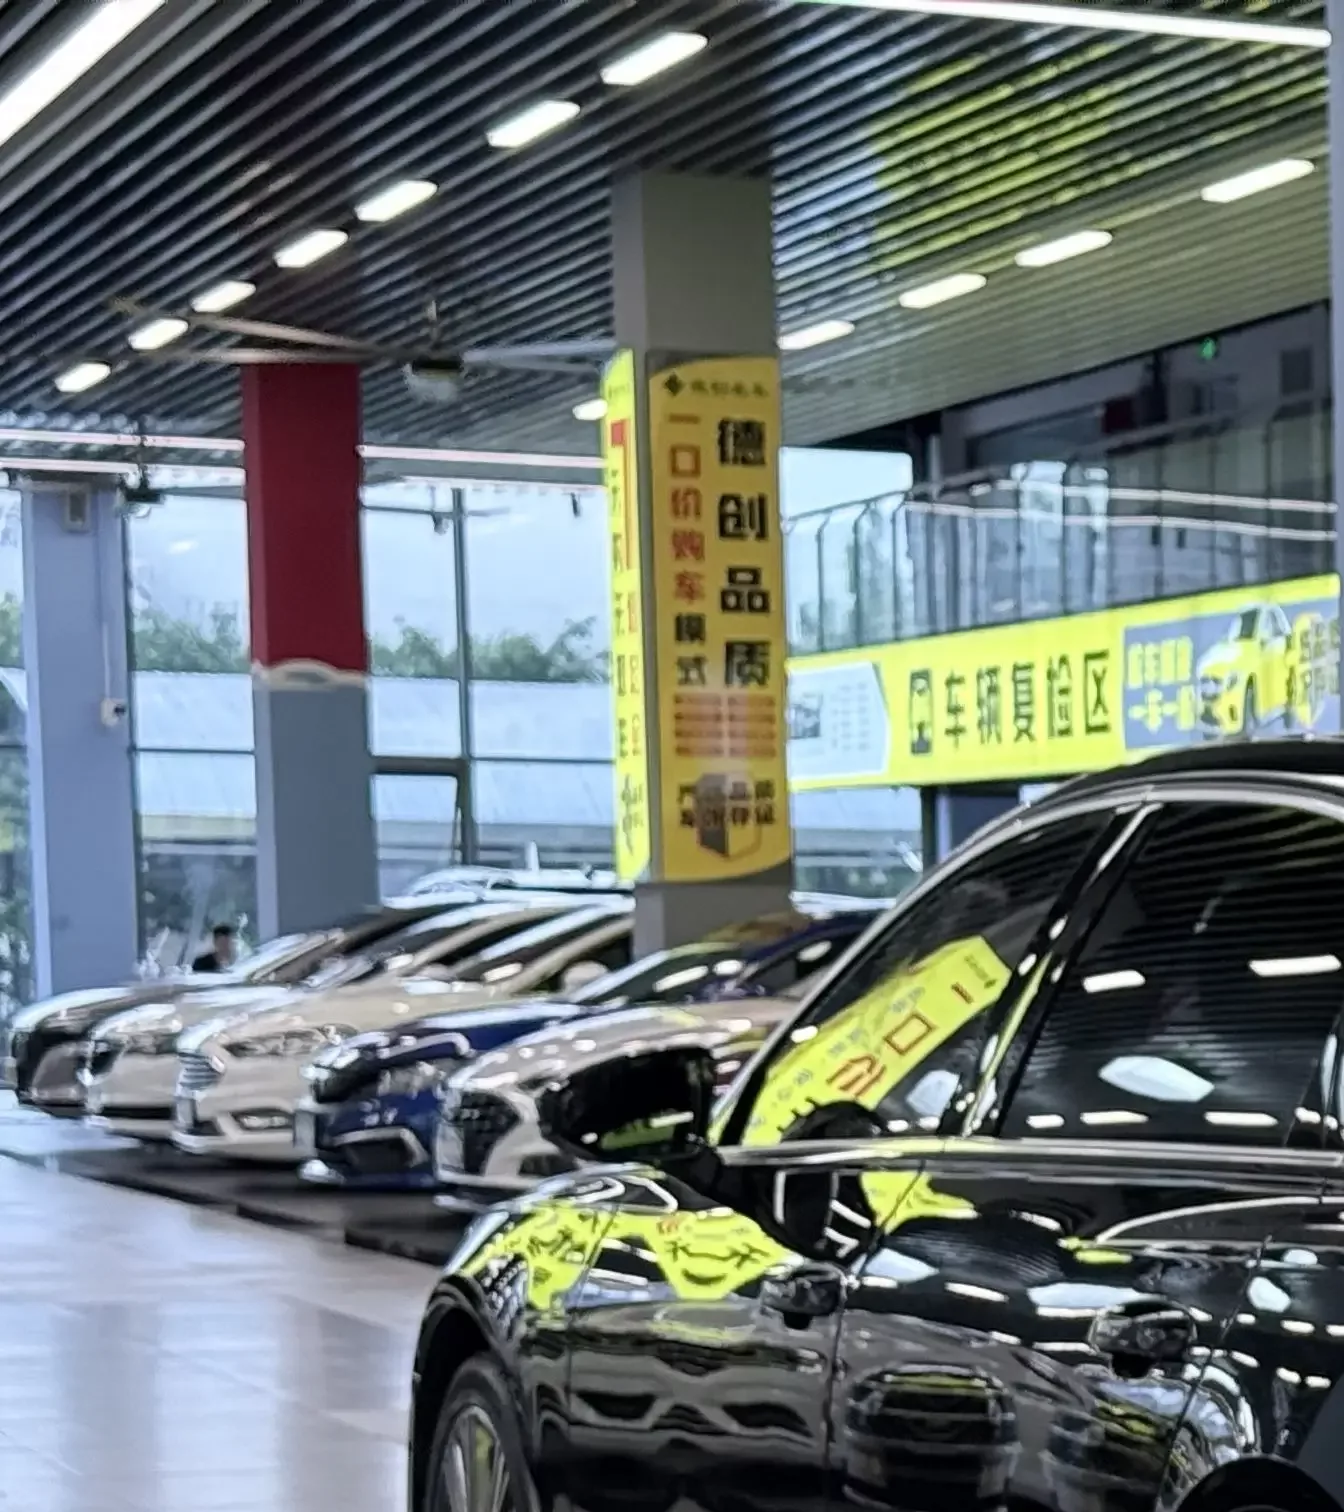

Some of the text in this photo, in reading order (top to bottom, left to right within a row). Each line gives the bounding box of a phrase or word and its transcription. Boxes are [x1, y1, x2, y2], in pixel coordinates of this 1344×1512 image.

[717, 418, 771, 687] 德创品质
[944, 648, 1111, 750] 车辆复检区
